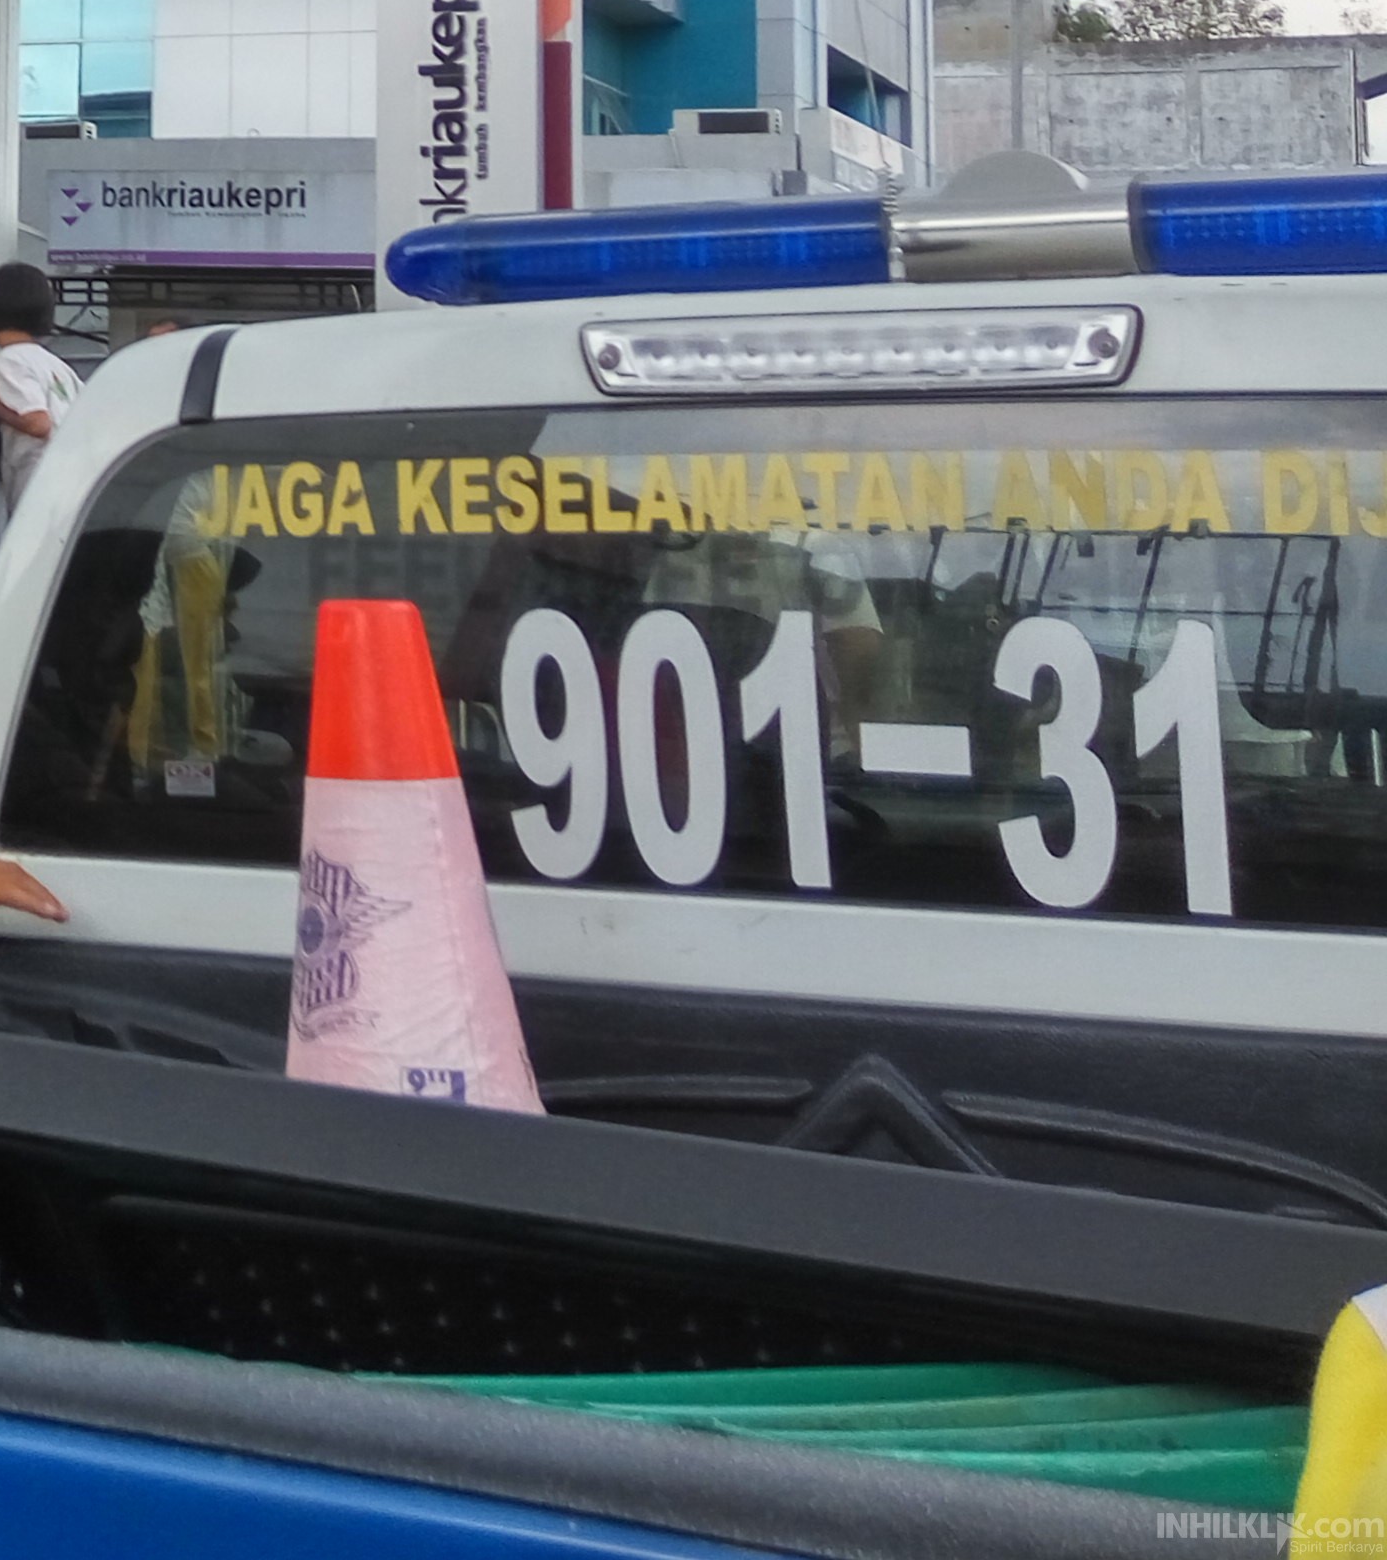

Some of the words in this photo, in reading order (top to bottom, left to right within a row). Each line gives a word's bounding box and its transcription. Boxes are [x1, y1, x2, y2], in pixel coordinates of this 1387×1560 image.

[101, 180, 307, 216] bankriaukepri
[196, 461, 376, 538] JAGA
[396, 451, 964, 535] KESELAMATAN
[992, 449, 1230, 534] ANDA
[500, 607, 1233, 917] 901-31
